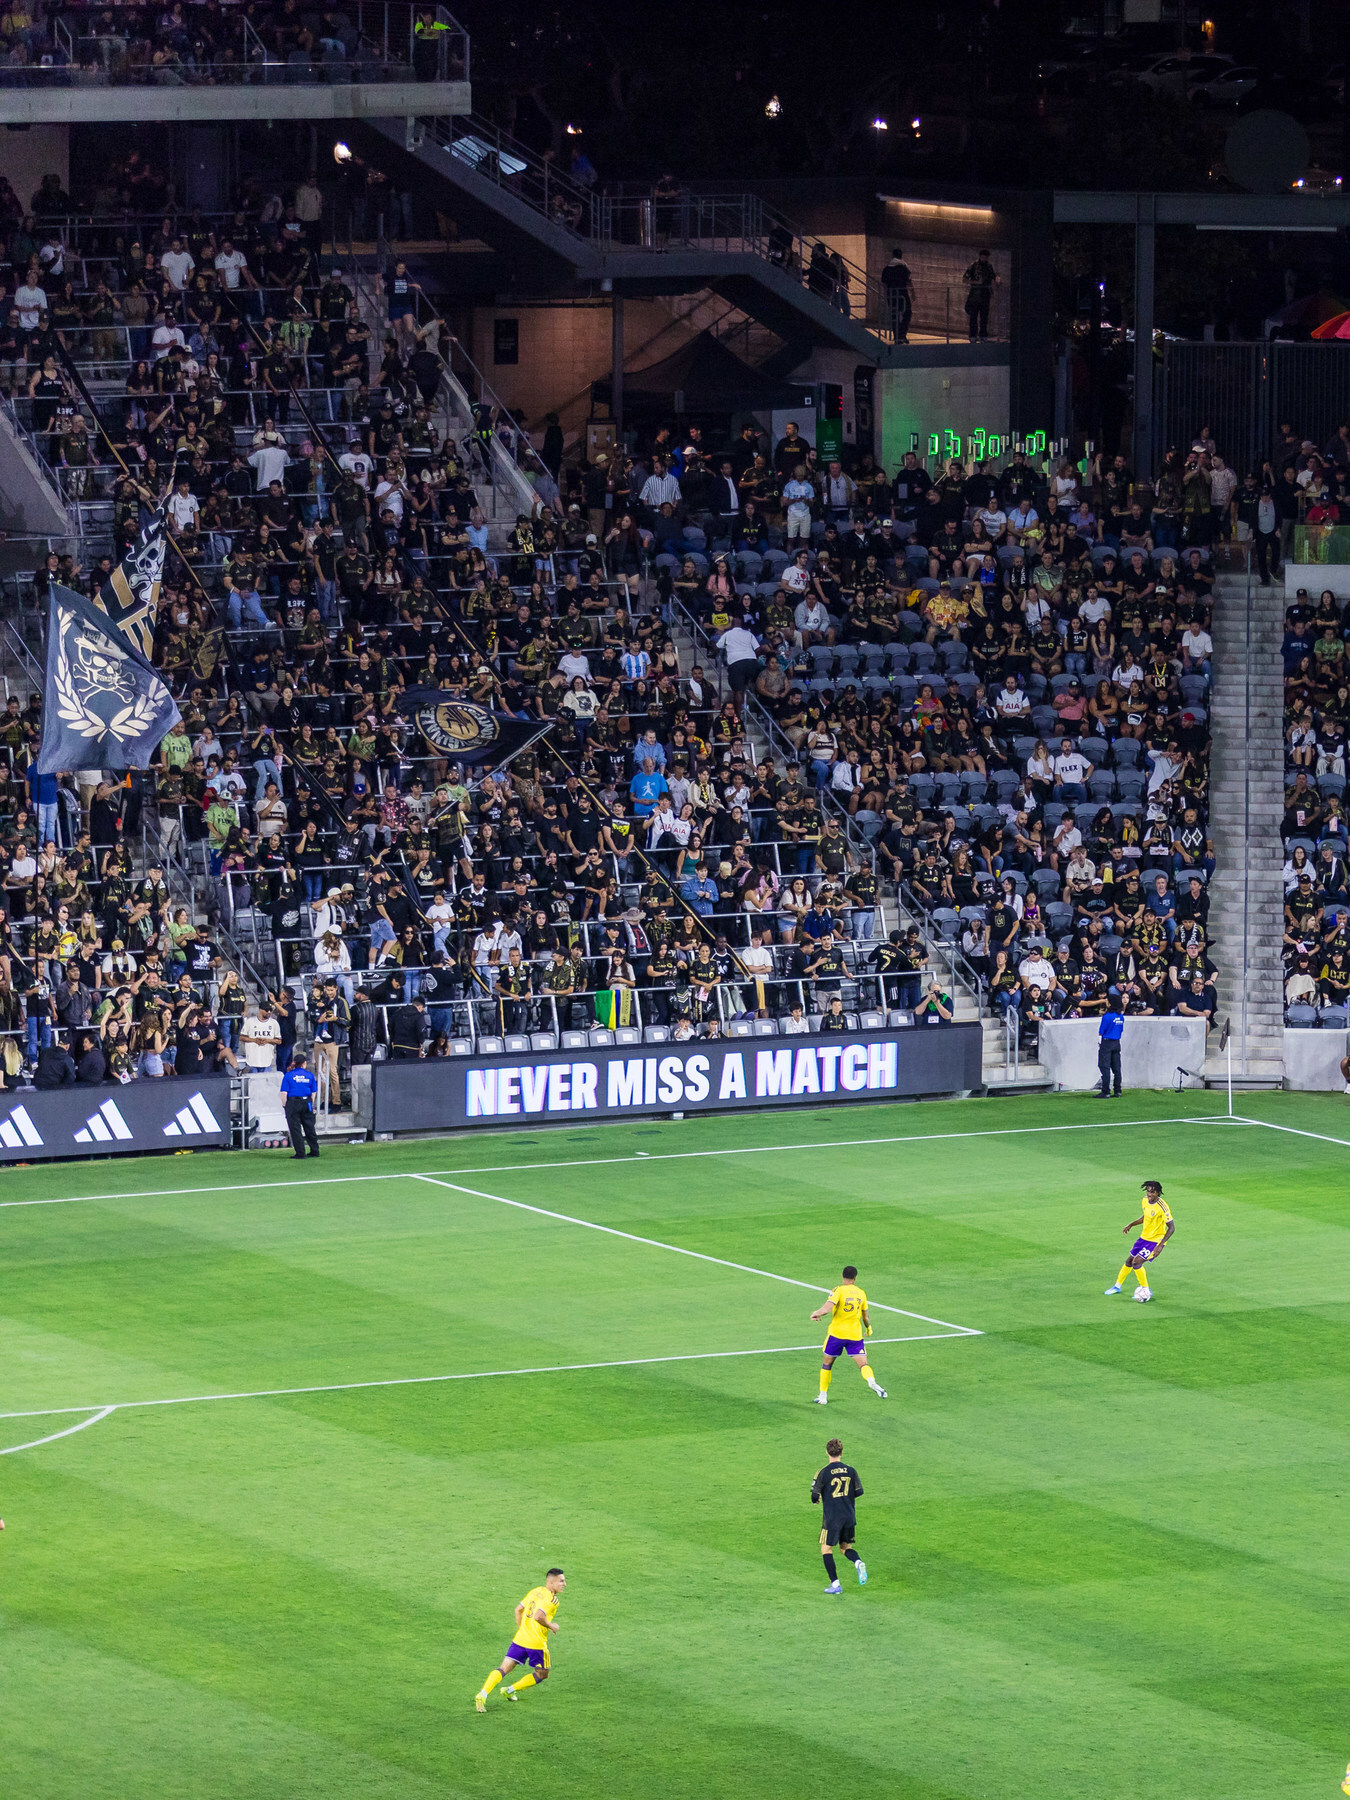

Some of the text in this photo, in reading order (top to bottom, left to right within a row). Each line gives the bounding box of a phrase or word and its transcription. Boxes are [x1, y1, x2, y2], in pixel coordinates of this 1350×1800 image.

[1061, 764, 1078, 773] FLEX
[822, 963, 837, 971] FLEX
[881, 955, 891, 970] 7
[466, 1042, 898, 1118] NEVER MISS A MATCH
[1138, 1247, 1151, 1260] 29
[830, 1476, 851, 1498] 27
